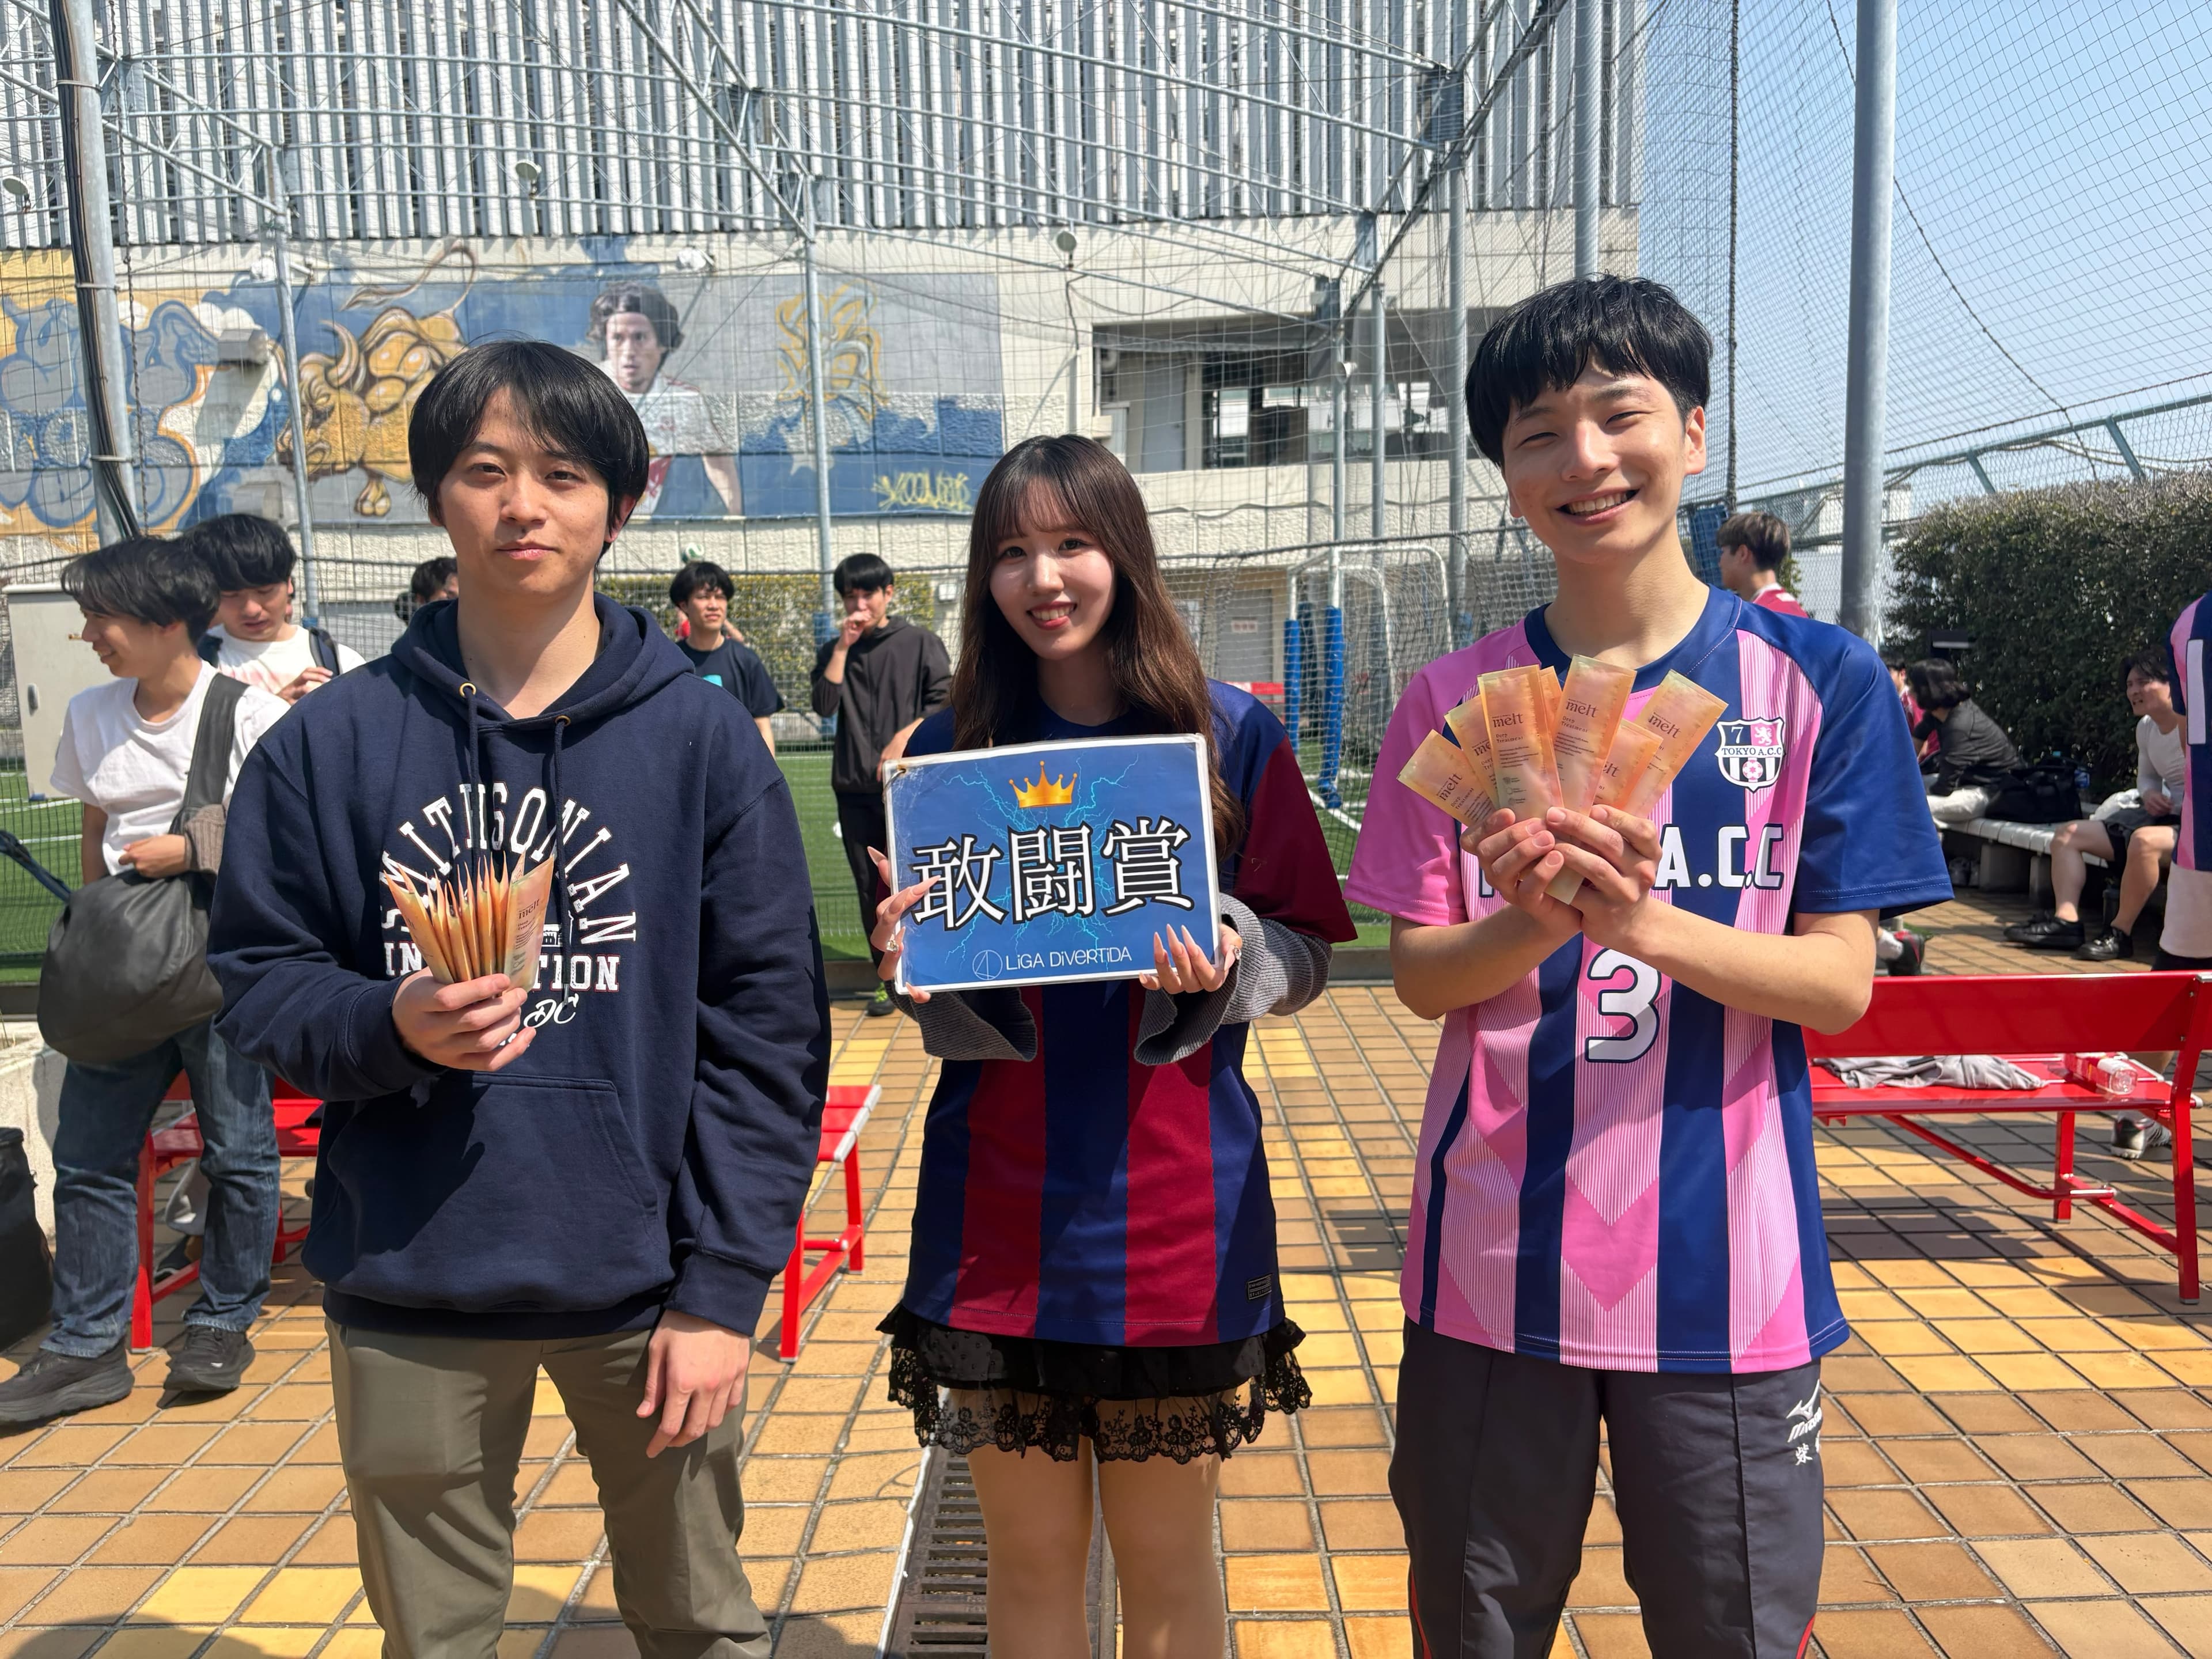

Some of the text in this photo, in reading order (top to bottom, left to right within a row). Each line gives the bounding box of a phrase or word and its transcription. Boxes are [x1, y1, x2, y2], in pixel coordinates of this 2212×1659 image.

[1566, 702, 1599, 718] melt
[1493, 713, 1524, 728] melt
[1648, 715, 1681, 738] melt
[1731, 726, 1744, 744] 7
[1721, 747, 1756, 755] TOKYO
[1440, 773, 1463, 801] melt
[909, 816, 1194, 931] 敢闘賞
[1585, 948, 1661, 1063] 3
